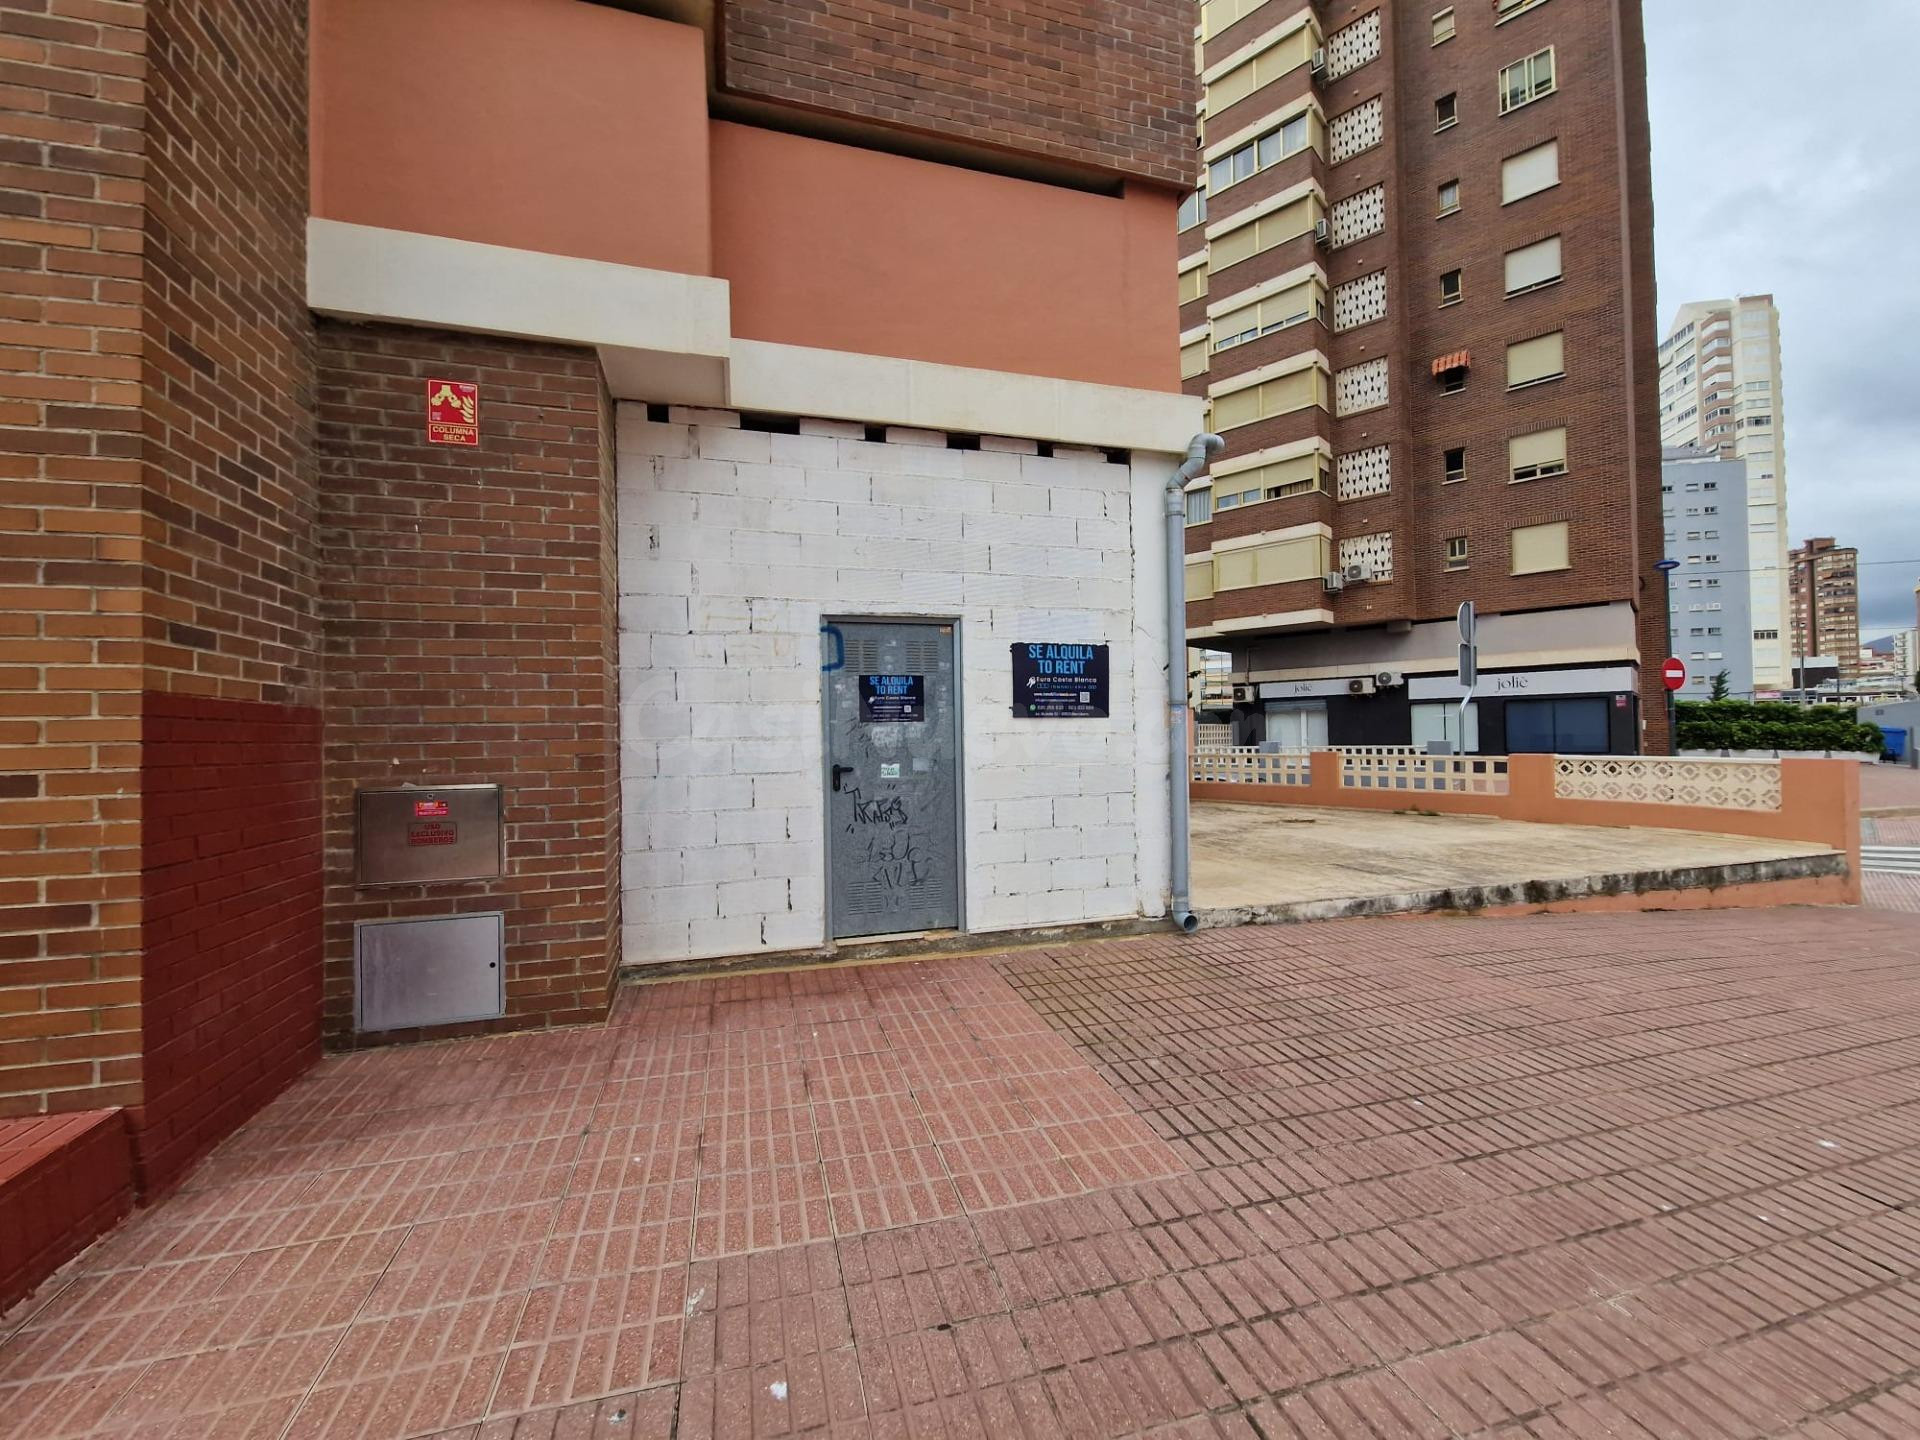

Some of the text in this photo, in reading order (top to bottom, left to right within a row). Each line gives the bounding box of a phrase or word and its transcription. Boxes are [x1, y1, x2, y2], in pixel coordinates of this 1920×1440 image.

[432, 426, 474, 435] COLUMNA
[1028, 645, 1094, 660] SE ALQUILA
[1037, 660, 1086, 674] TO RENT
[869, 675, 914, 686] SE ALQUILA
[875, 685, 908, 695] TO RENT
